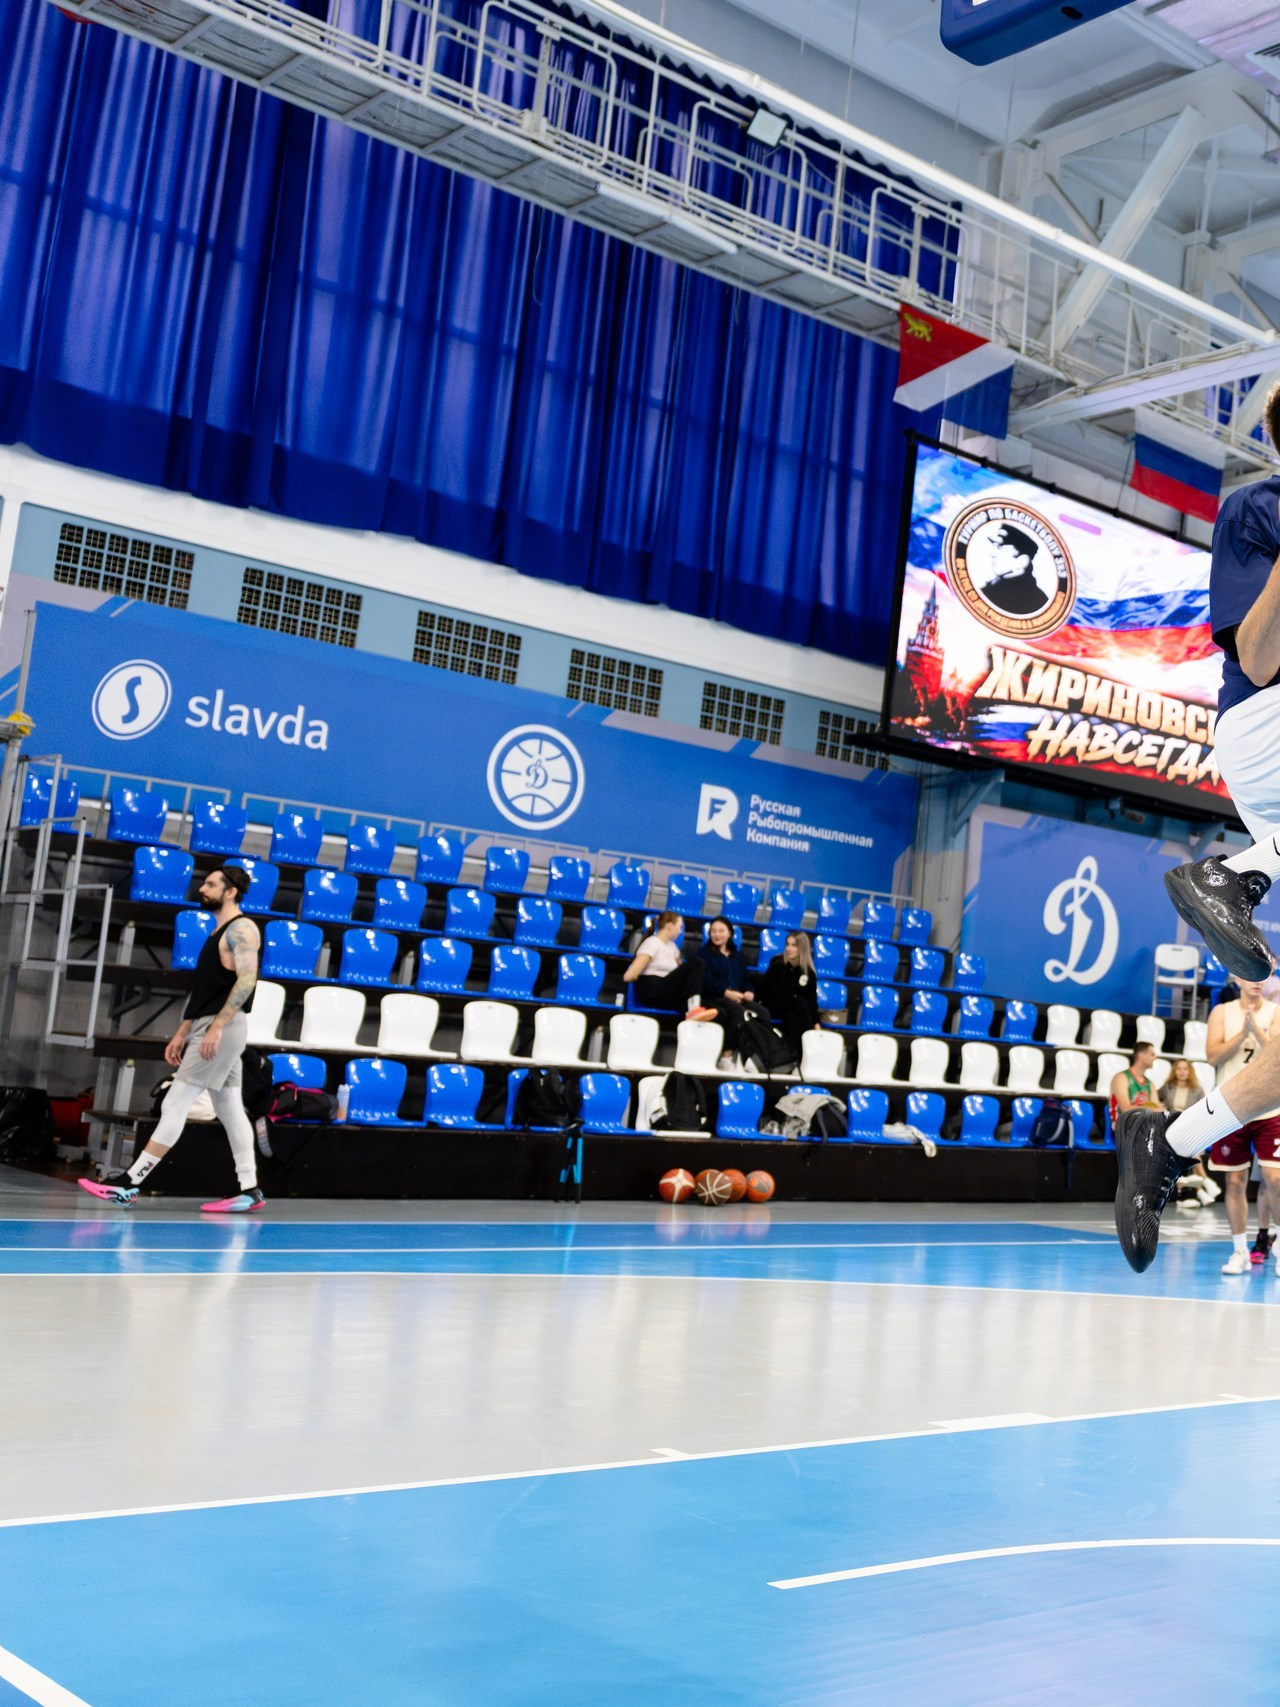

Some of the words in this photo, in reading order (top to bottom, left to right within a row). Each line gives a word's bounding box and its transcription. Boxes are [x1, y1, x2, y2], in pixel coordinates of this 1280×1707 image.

[975, 645, 1217, 746] ЖИРИНОВС
[185, 689, 329, 751] slavda
[751, 795, 801, 817] Русская
[746, 828, 810, 852] Компания
[748, 811, 873, 848] Рыбопромышленная
[1243, 1048, 1254, 1063] 7
